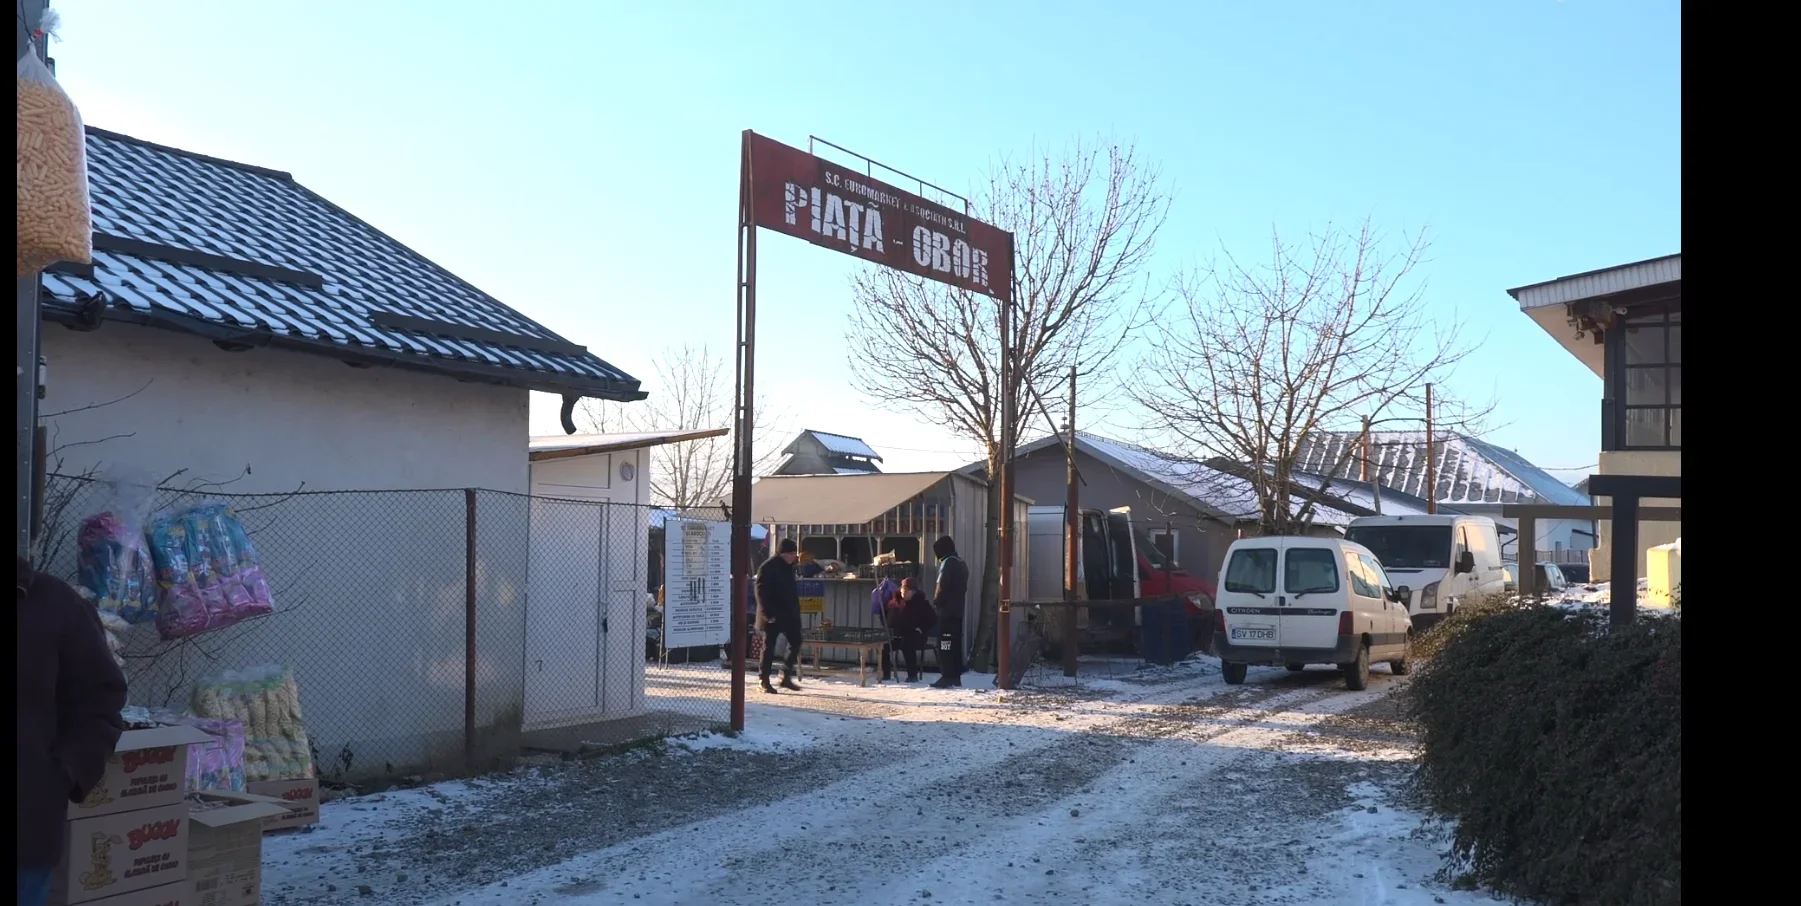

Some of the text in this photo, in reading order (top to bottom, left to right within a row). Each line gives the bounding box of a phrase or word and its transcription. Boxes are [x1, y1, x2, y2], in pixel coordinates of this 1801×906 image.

[844, 179, 900, 208] EUROMARKET
[912, 225, 989, 288] OBOR
[1236, 630, 1274, 639] SV 17 DHB
[127, 818, 181, 851] BUGGY
